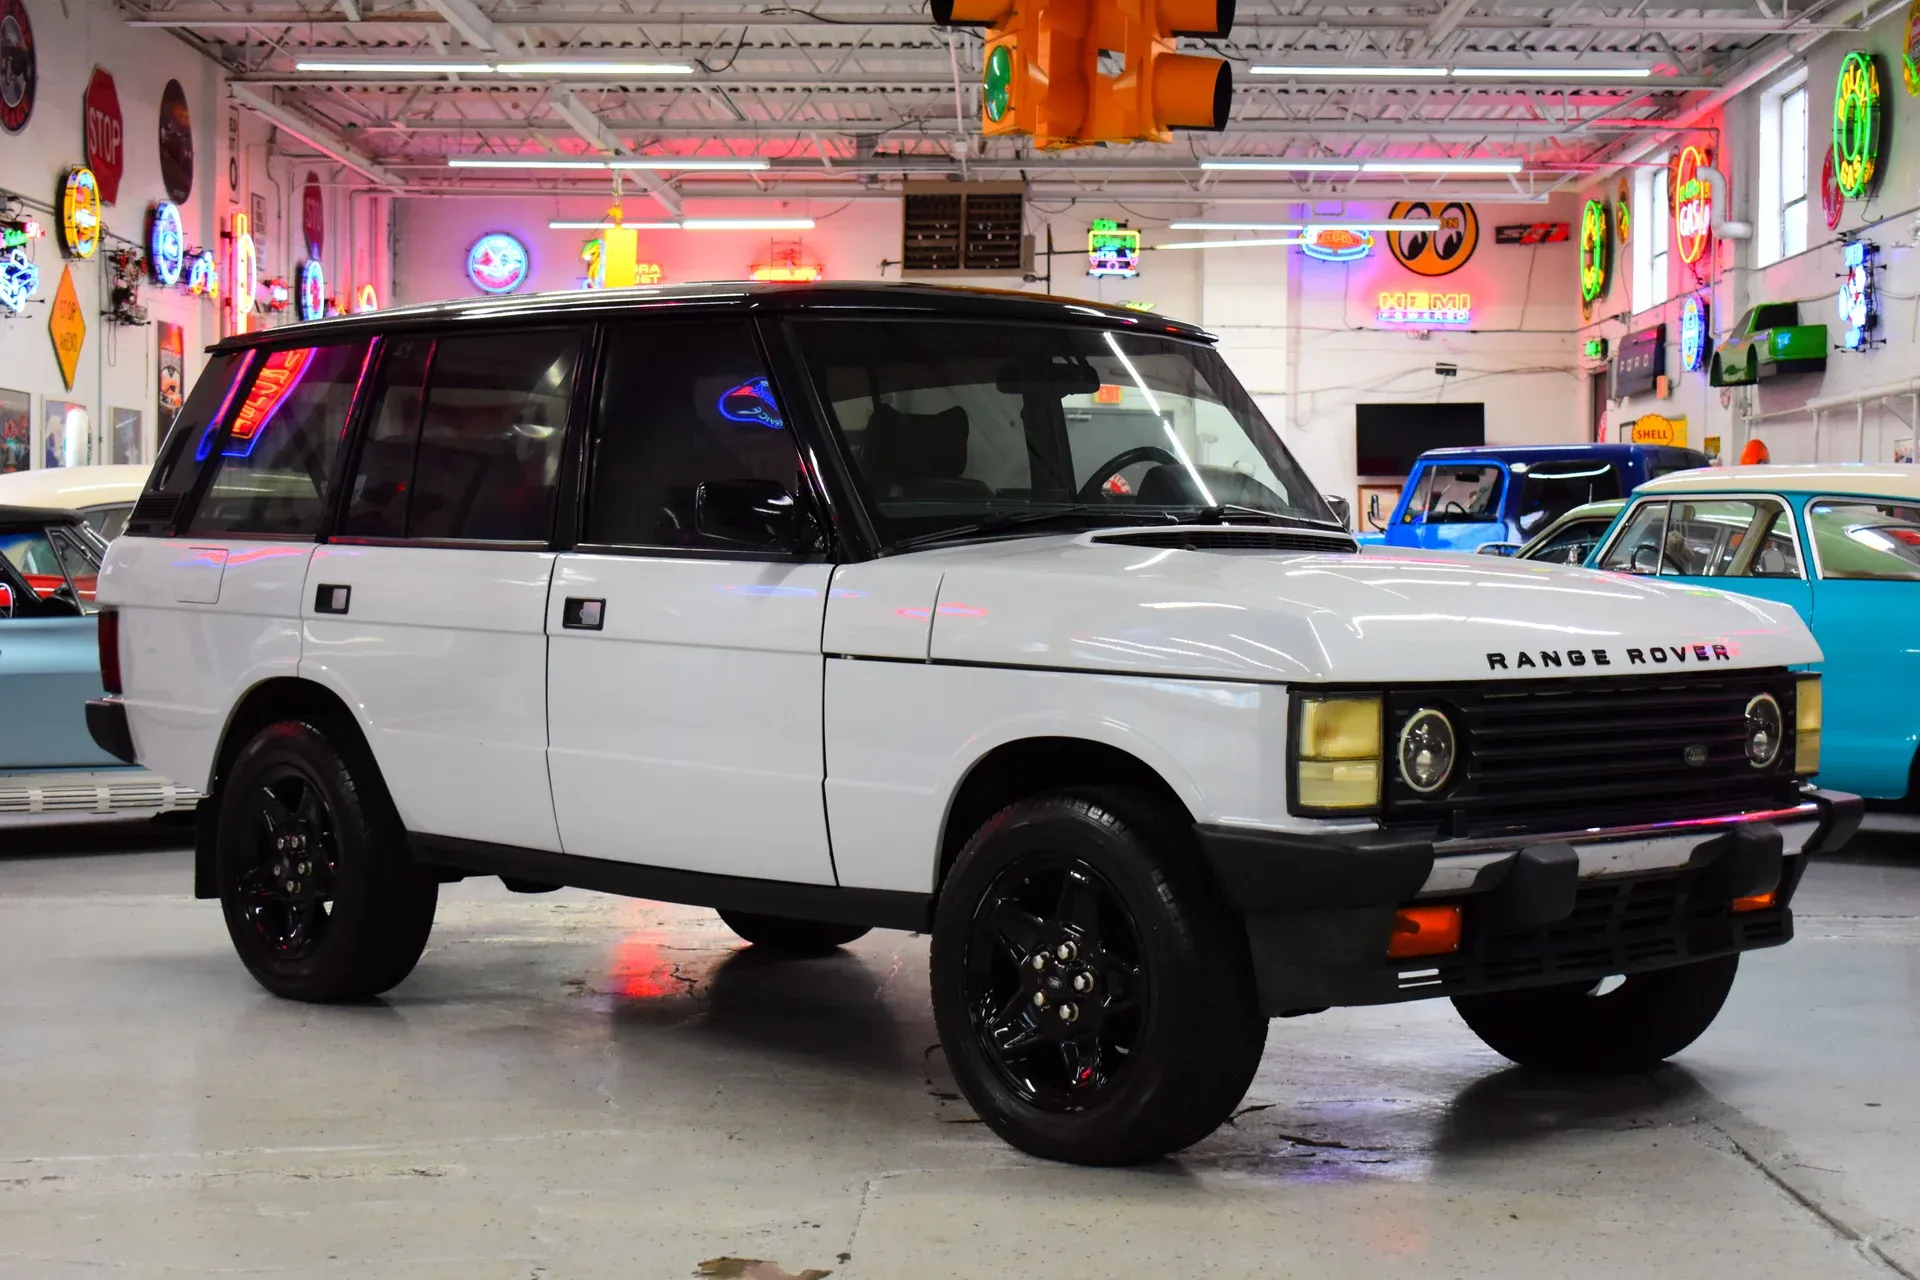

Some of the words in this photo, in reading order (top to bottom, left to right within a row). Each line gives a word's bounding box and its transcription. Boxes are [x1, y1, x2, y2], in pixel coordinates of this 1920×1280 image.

[89, 107, 120, 164] STOP
[1379, 292, 1470, 311] HEMI
[1380, 311, 1467, 321] POWERED
[1620, 354, 1650, 374] FORD
[1637, 429, 1668, 440] SHELL
[1486, 649, 1611, 670] RANGE
[1625, 644, 1730, 664] ROVER
